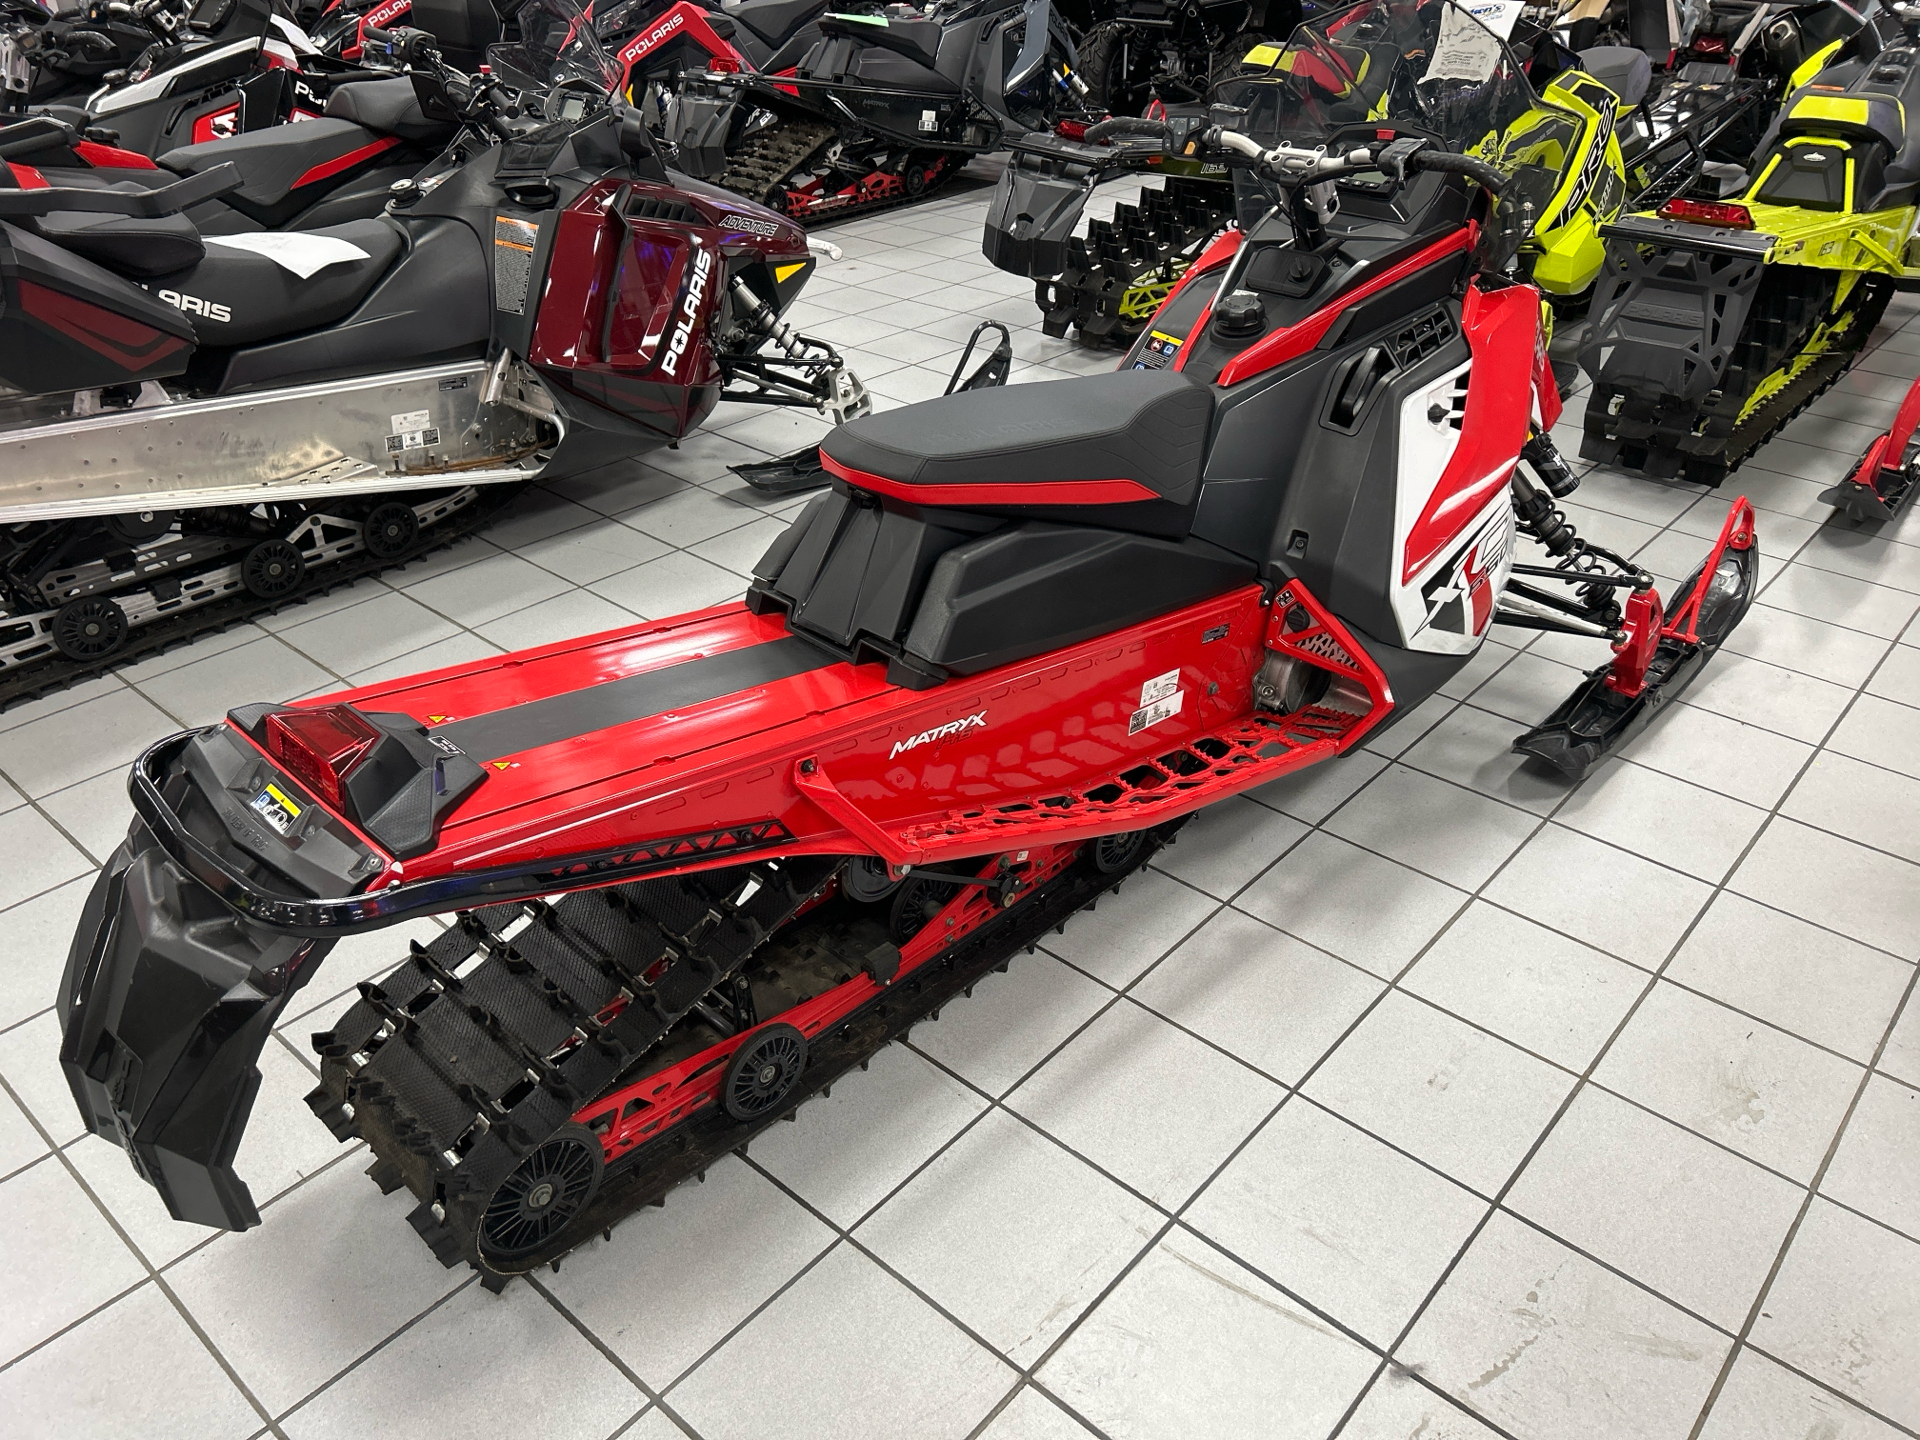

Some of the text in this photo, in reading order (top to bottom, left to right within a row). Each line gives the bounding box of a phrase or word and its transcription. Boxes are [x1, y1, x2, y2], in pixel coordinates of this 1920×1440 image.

[625, 13, 684, 61] POLARIS
[1560, 97, 1613, 231] PRO
[718, 214, 779, 236] ADVENTURE
[660, 248, 712, 377] POLARIS
[1626, 304, 1703, 326] POLARIS
[888, 709, 988, 760] MATRYX
